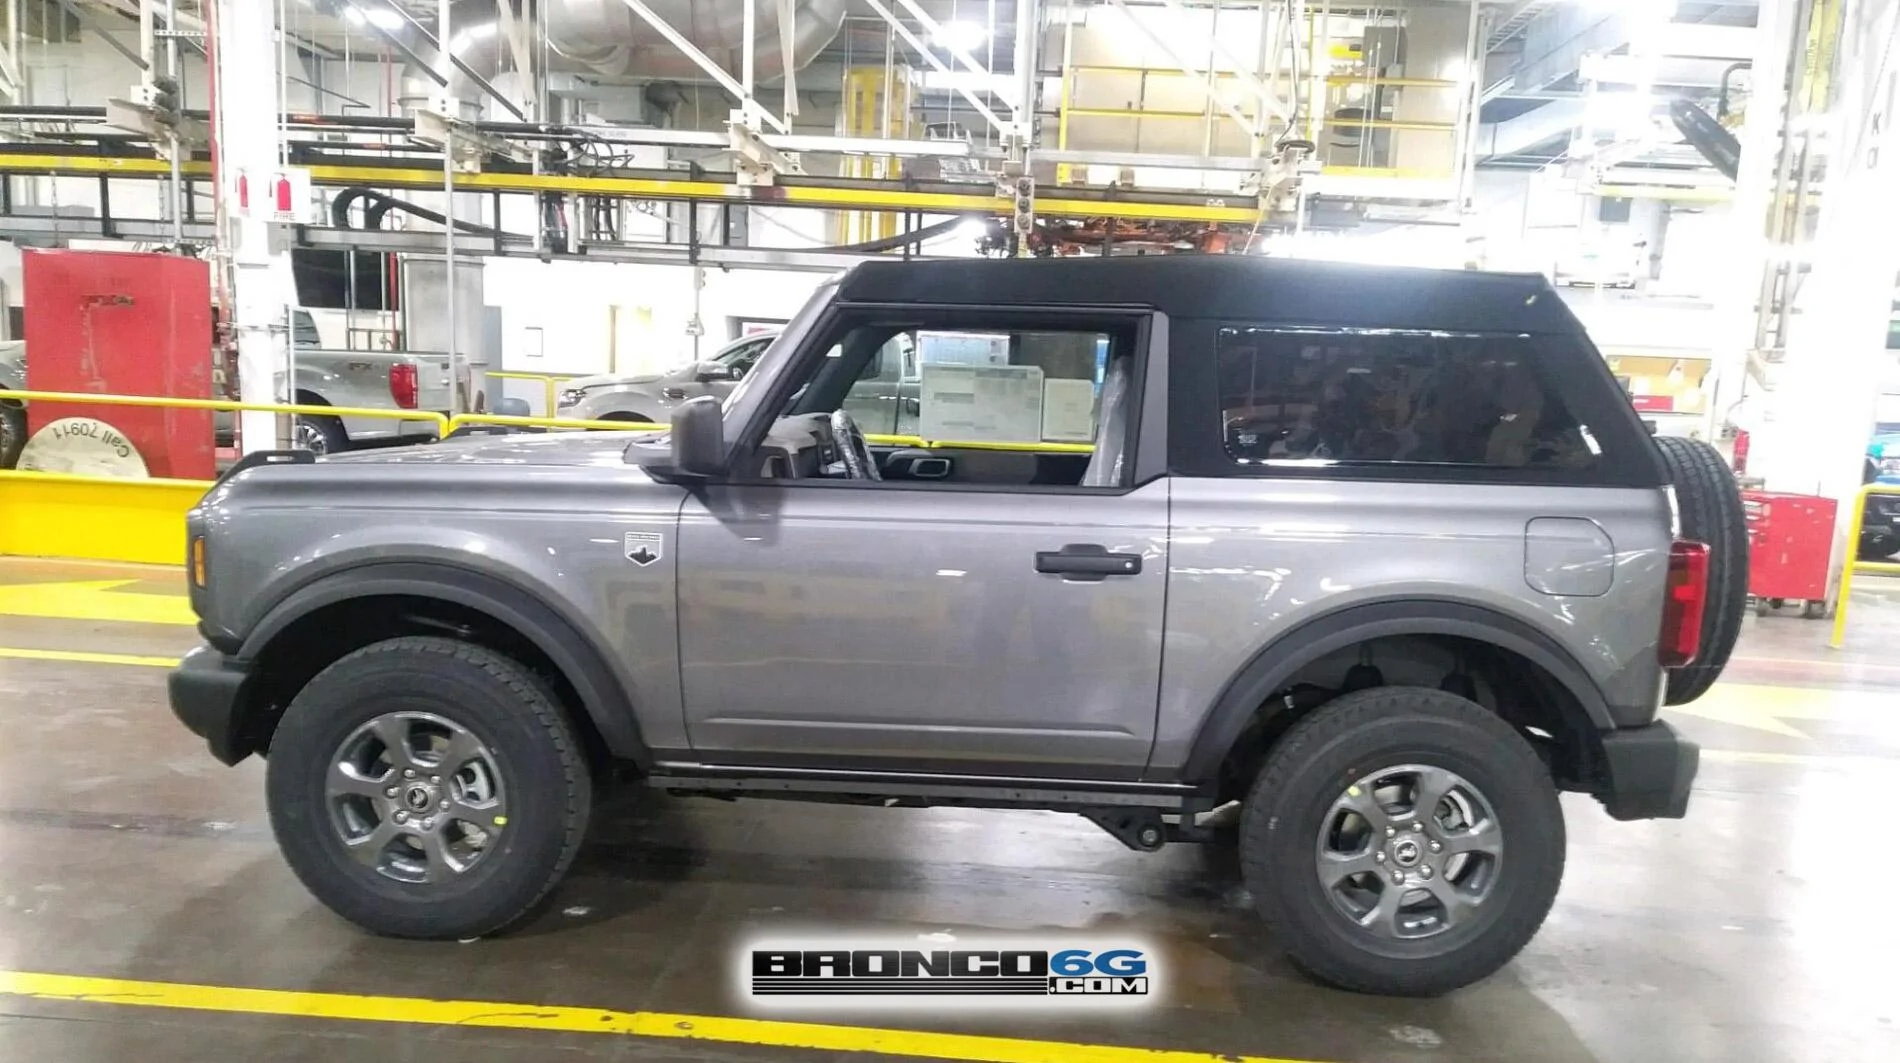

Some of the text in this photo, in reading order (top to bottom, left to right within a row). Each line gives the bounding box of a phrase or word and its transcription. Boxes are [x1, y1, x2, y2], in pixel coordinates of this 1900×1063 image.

[273, 211, 296, 221] FIRE
[53, 422, 130, 458] Call 70911
